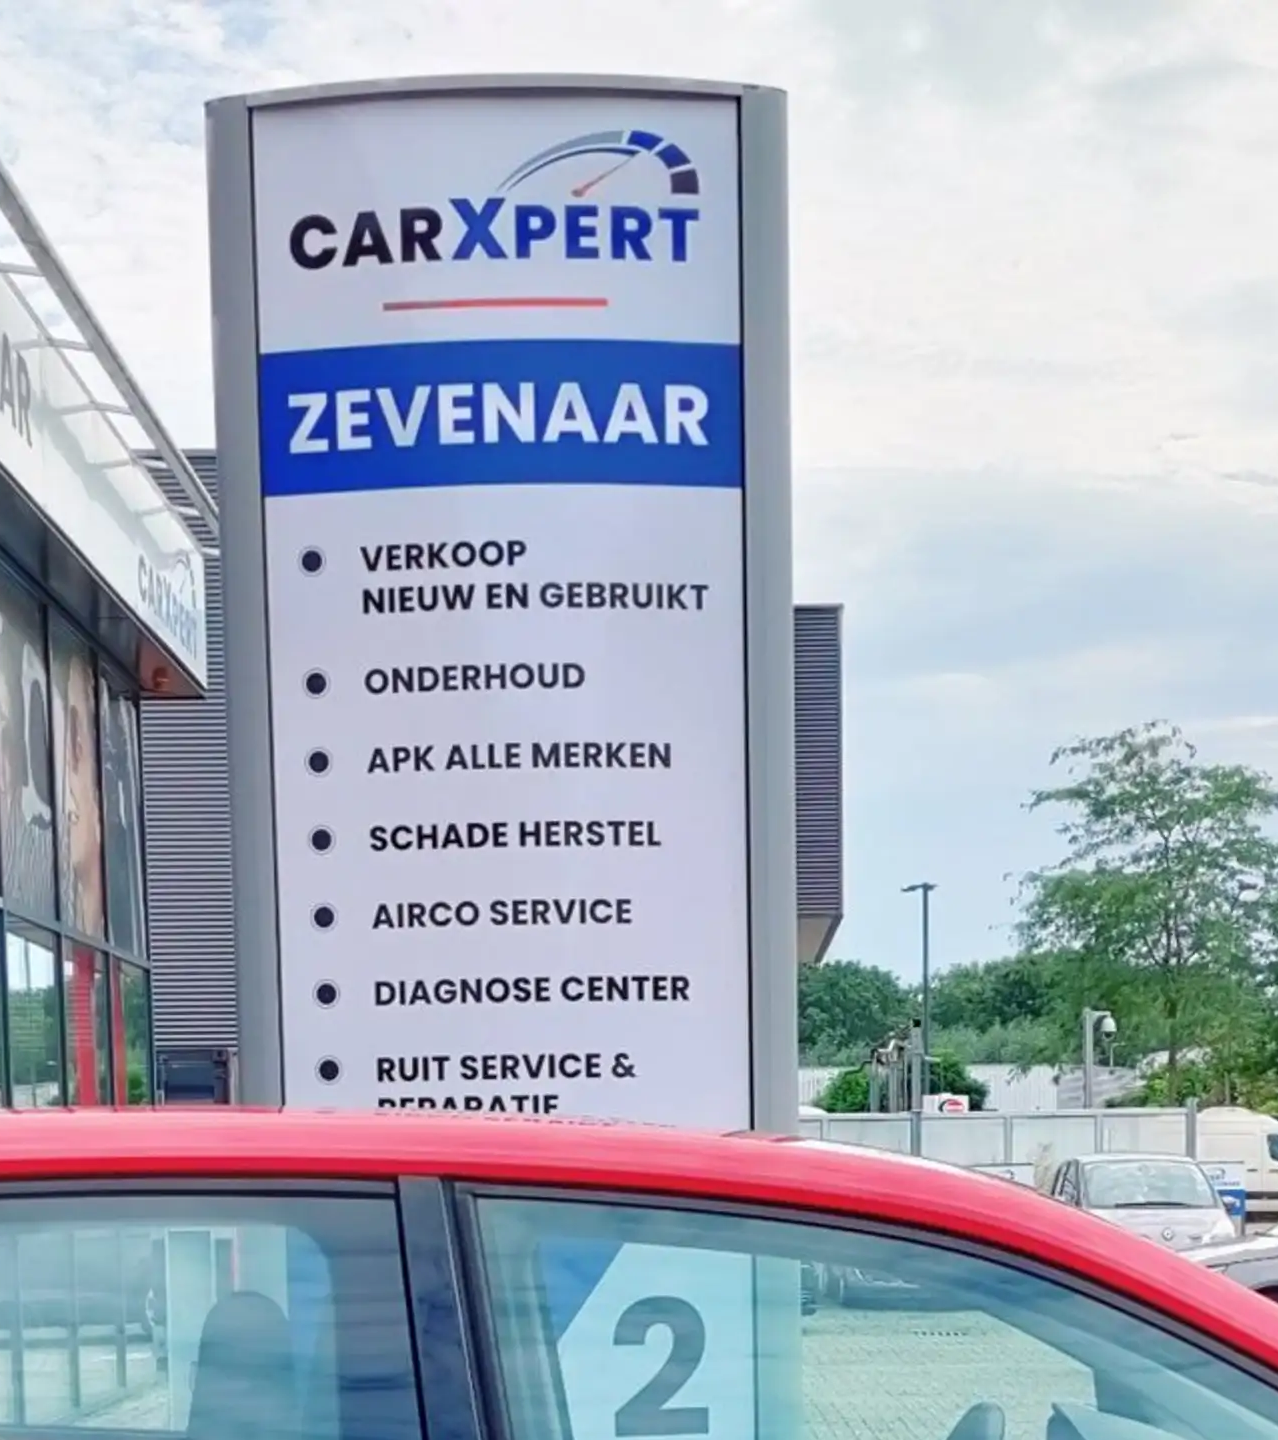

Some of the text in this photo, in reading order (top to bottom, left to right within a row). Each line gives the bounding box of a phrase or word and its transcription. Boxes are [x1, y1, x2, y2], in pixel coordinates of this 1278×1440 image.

[290, 197, 700, 269] CARXPERT
[287, 381, 709, 454] ZEVENAAR
[360, 540, 527, 572] VERKOOP
[361, 582, 709, 614] NIEUW EN GEBRUIKT
[364, 662, 586, 695] ONDERHOUD
[367, 742, 672, 773] APK ALLE MERKEN
[369, 820, 662, 852] SCHADE HERSTEL
[372, 898, 633, 929] AIRCO SERVICE
[374, 975, 691, 1006] DIAGNOSE CENTER
[376, 1053, 637, 1082] RUIT SERVICE &
[612, 1295, 709, 1437] 2
